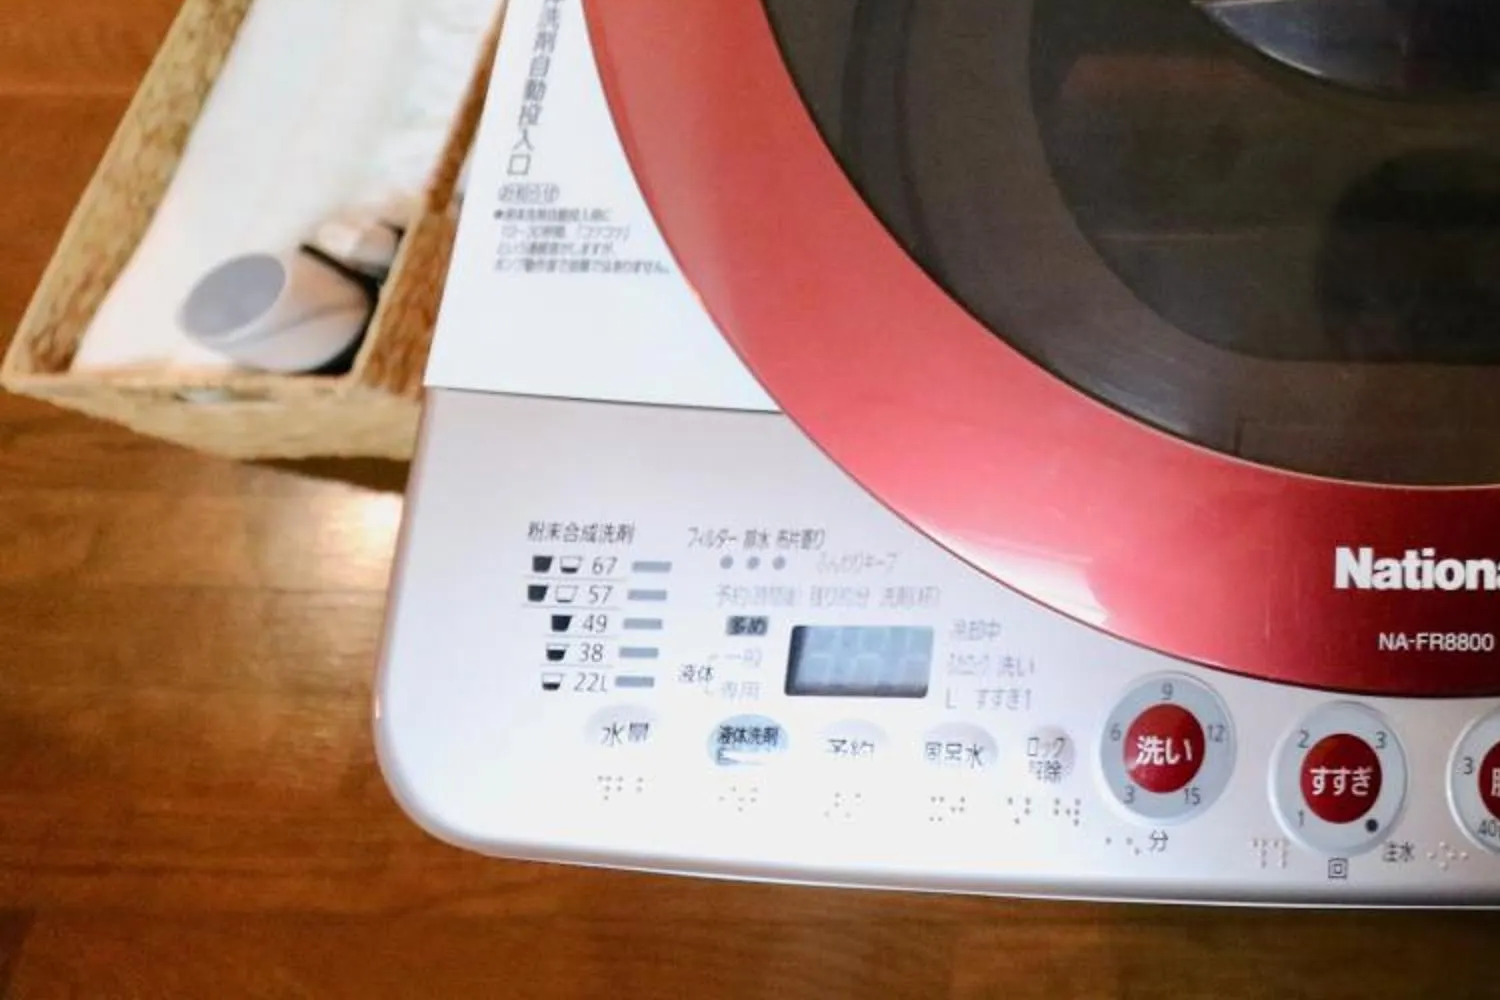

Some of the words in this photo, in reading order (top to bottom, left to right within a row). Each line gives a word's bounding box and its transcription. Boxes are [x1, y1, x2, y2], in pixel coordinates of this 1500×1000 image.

[527, 521, 635, 545] 粉末合成洗剤
[591, 556, 618, 575] 67
[587, 586, 613, 605] 57
[581, 614, 607, 633] 49
[1378, 632, 1496, 651] NA-FR8800
[579, 644, 603, 663] 38
[1161, 683, 1173, 701] 9
[1110, 724, 1122, 742] 6
[1207, 724, 1225, 743] 12
[1297, 730, 1311, 749] 2
[1375, 730, 1388, 750] 3
[1135, 735, 1193, 766] 洗い
[1462, 756, 1474, 776] 3
[1309, 767, 1373, 796] すすぎ
[1123, 786, 1136, 805] 3
[1183, 786, 1201, 806] 15
[1297, 810, 1305, 828] 1
[1149, 830, 1169, 851] 分
[1328, 857, 1348, 879] 回
